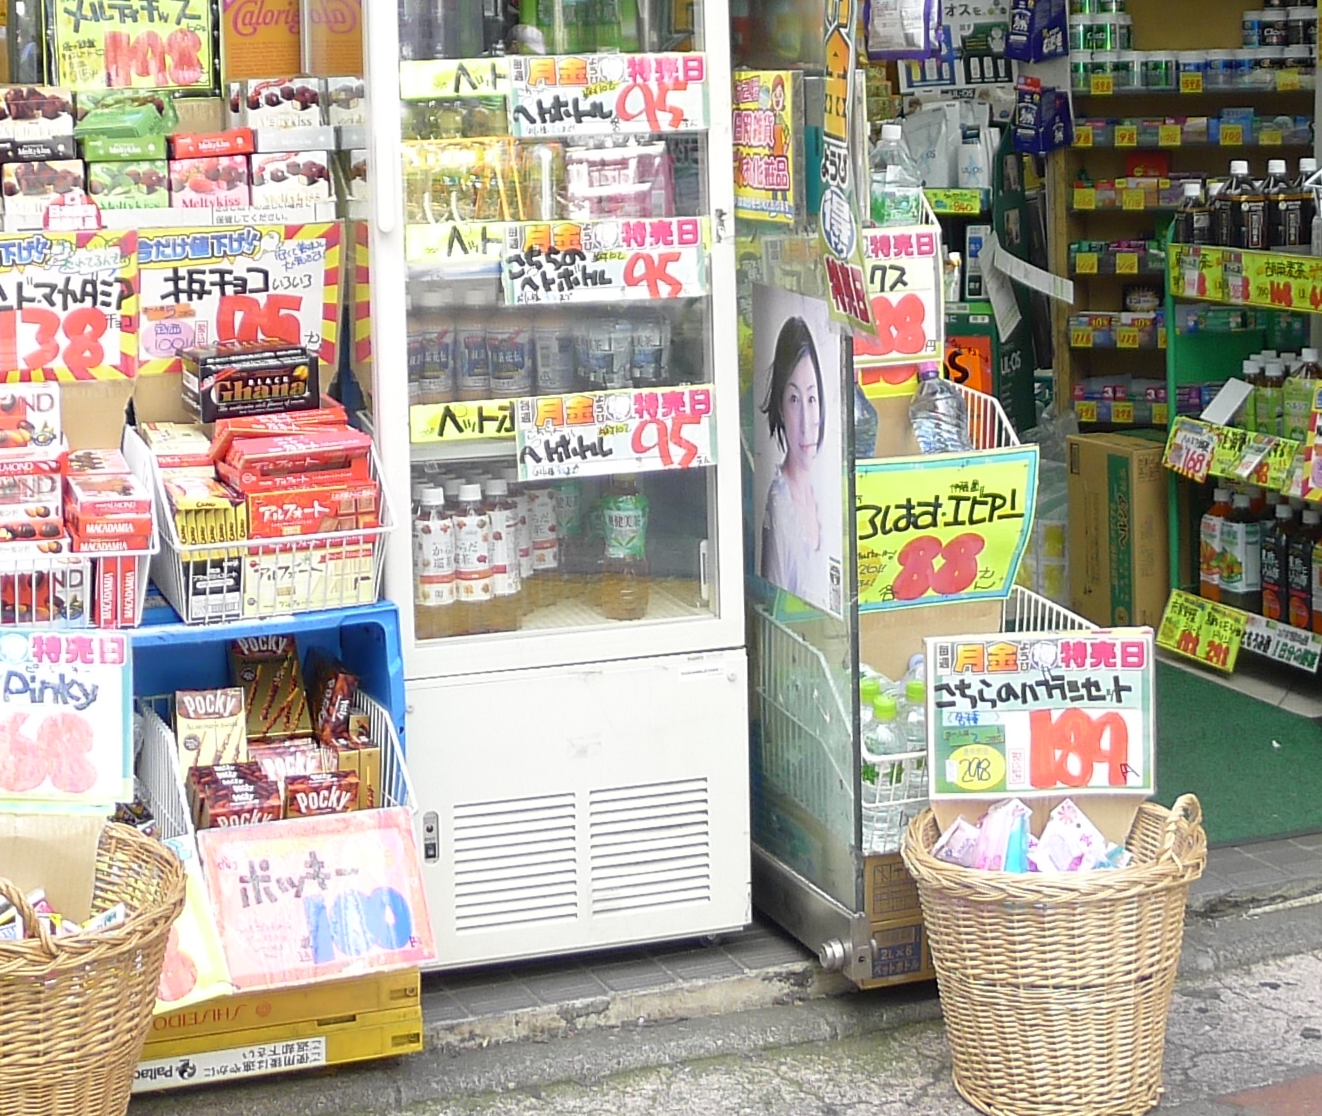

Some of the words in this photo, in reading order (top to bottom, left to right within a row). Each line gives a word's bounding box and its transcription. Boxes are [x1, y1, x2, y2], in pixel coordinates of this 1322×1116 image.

[621, 219, 701, 249] 特売日
[215, 378, 307, 405] Ghana
[632, 387, 714, 419] 特売日
[258, 500, 330, 521] アルフォート
[892, 533, 985, 601] 88
[954, 642, 1020, 675] 月金
[1060, 639, 1147, 670] 特売日
